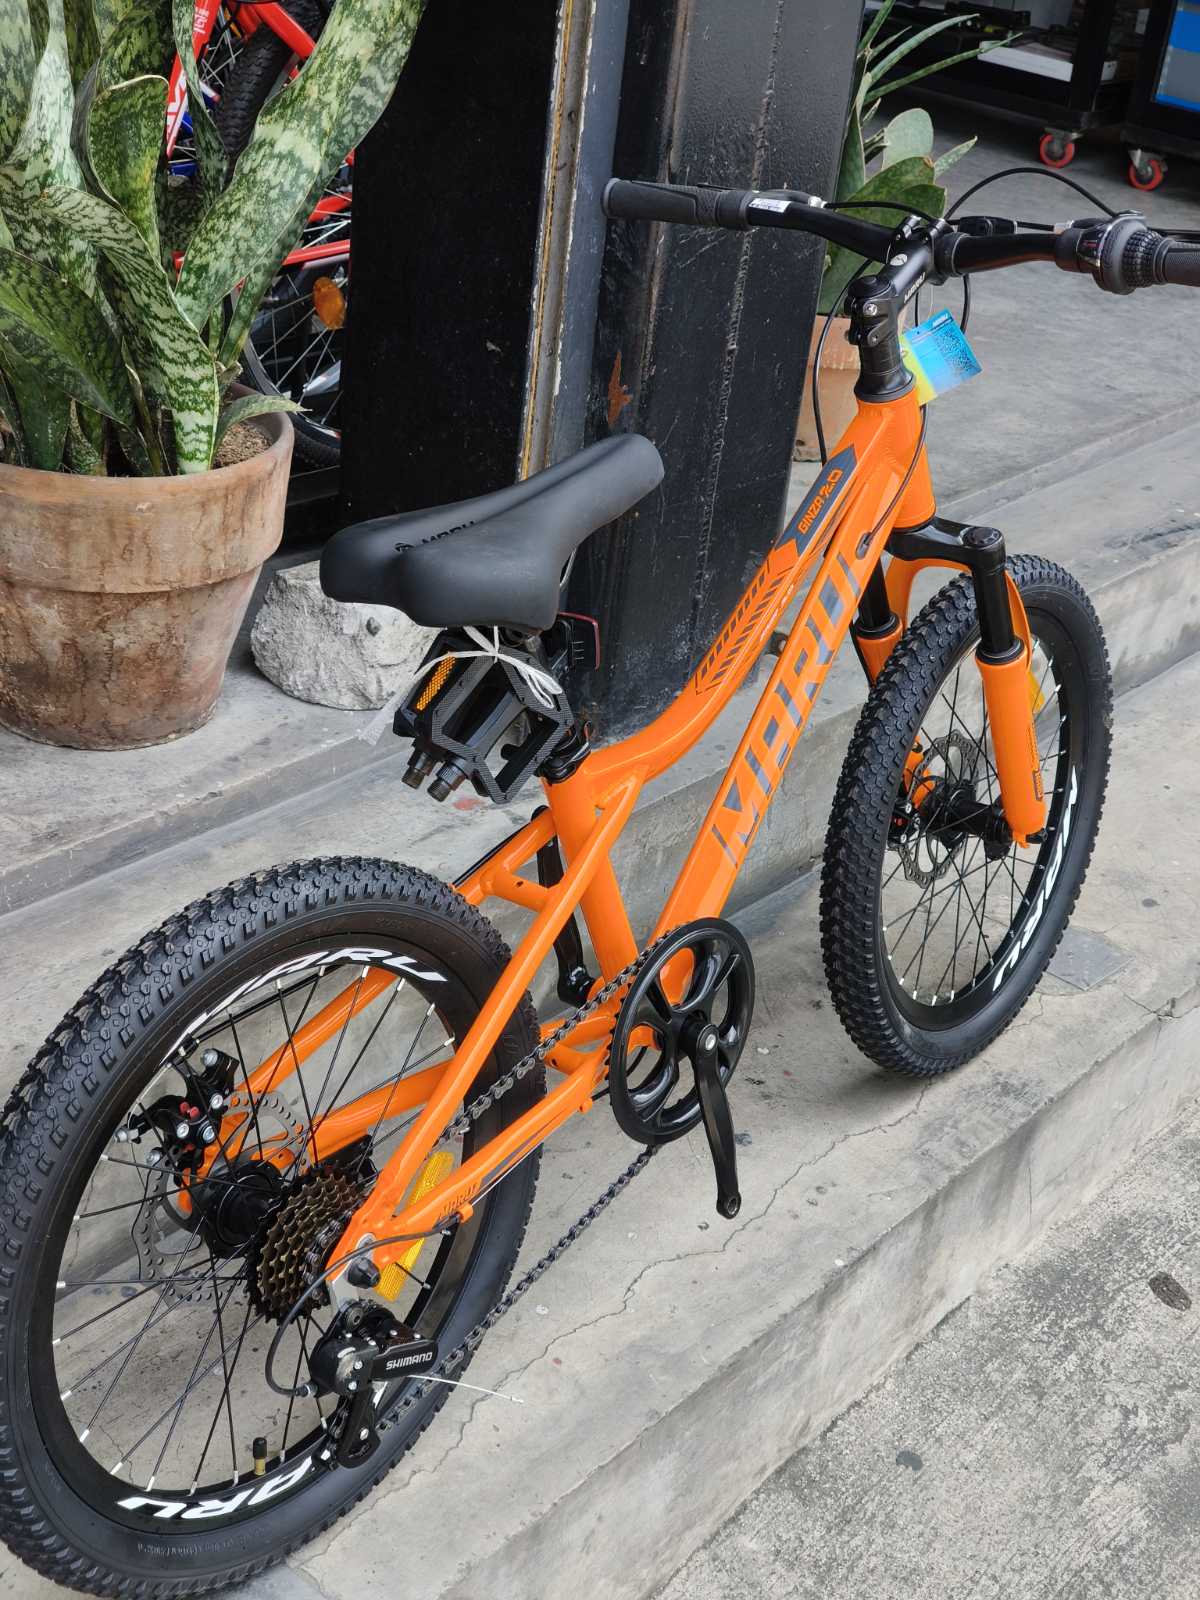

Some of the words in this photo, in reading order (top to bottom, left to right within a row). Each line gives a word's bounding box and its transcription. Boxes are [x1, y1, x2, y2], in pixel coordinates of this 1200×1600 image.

[797, 495, 824, 535] GINZA
[819, 469, 844, 497] 2.0
[385, 1351, 433, 1370] SHIMANO
[117, 1449, 331, 1519] ARU
